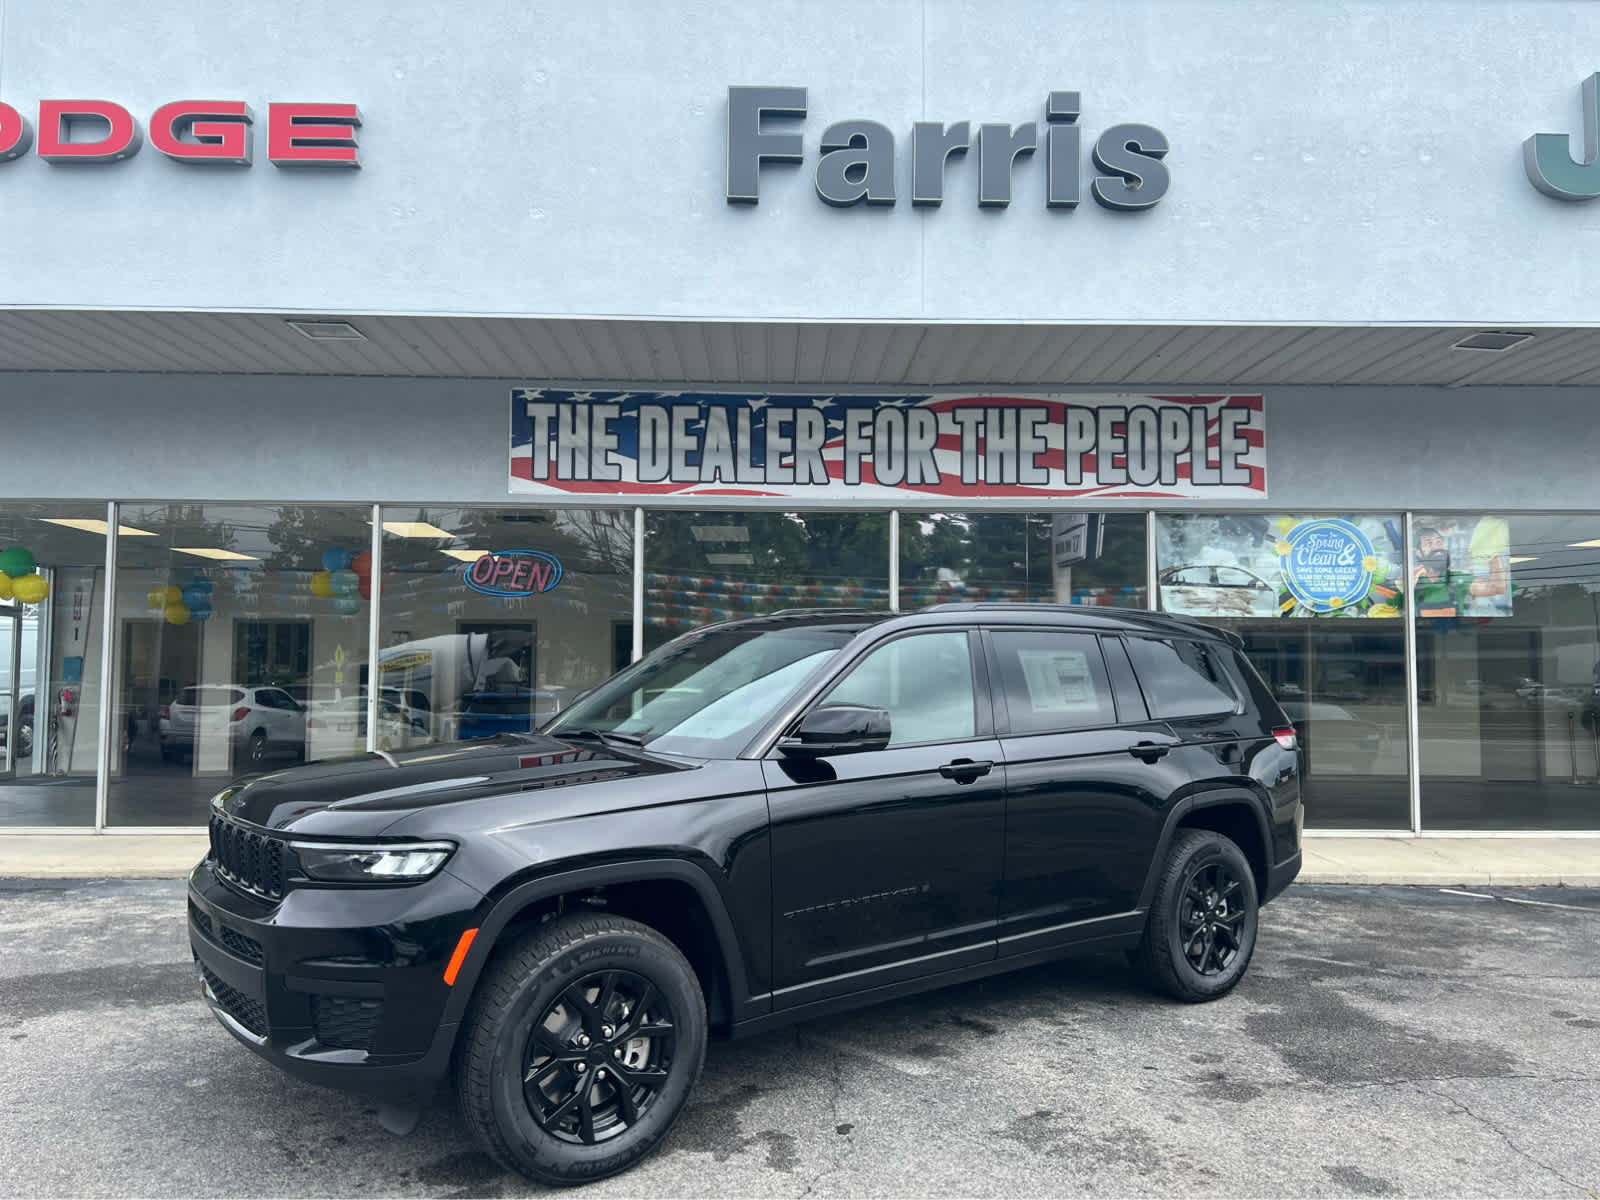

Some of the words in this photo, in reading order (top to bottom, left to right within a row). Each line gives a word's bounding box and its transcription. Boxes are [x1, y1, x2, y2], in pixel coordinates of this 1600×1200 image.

[0, 100, 361, 167] DGE
[727, 86, 1170, 209] Farris
[526, 401, 622, 482] THE
[637, 403, 831, 485] DEALER
[843, 405, 942, 487] FOR
[953, 406, 1051, 487] THE
[1063, 406, 1253, 487] PEOPLE
[1295, 545, 1337, 566] Clean
[1337, 543, 1356, 567] &
[1307, 532, 1344, 554] Spring
[473, 555, 552, 592] OPEN
